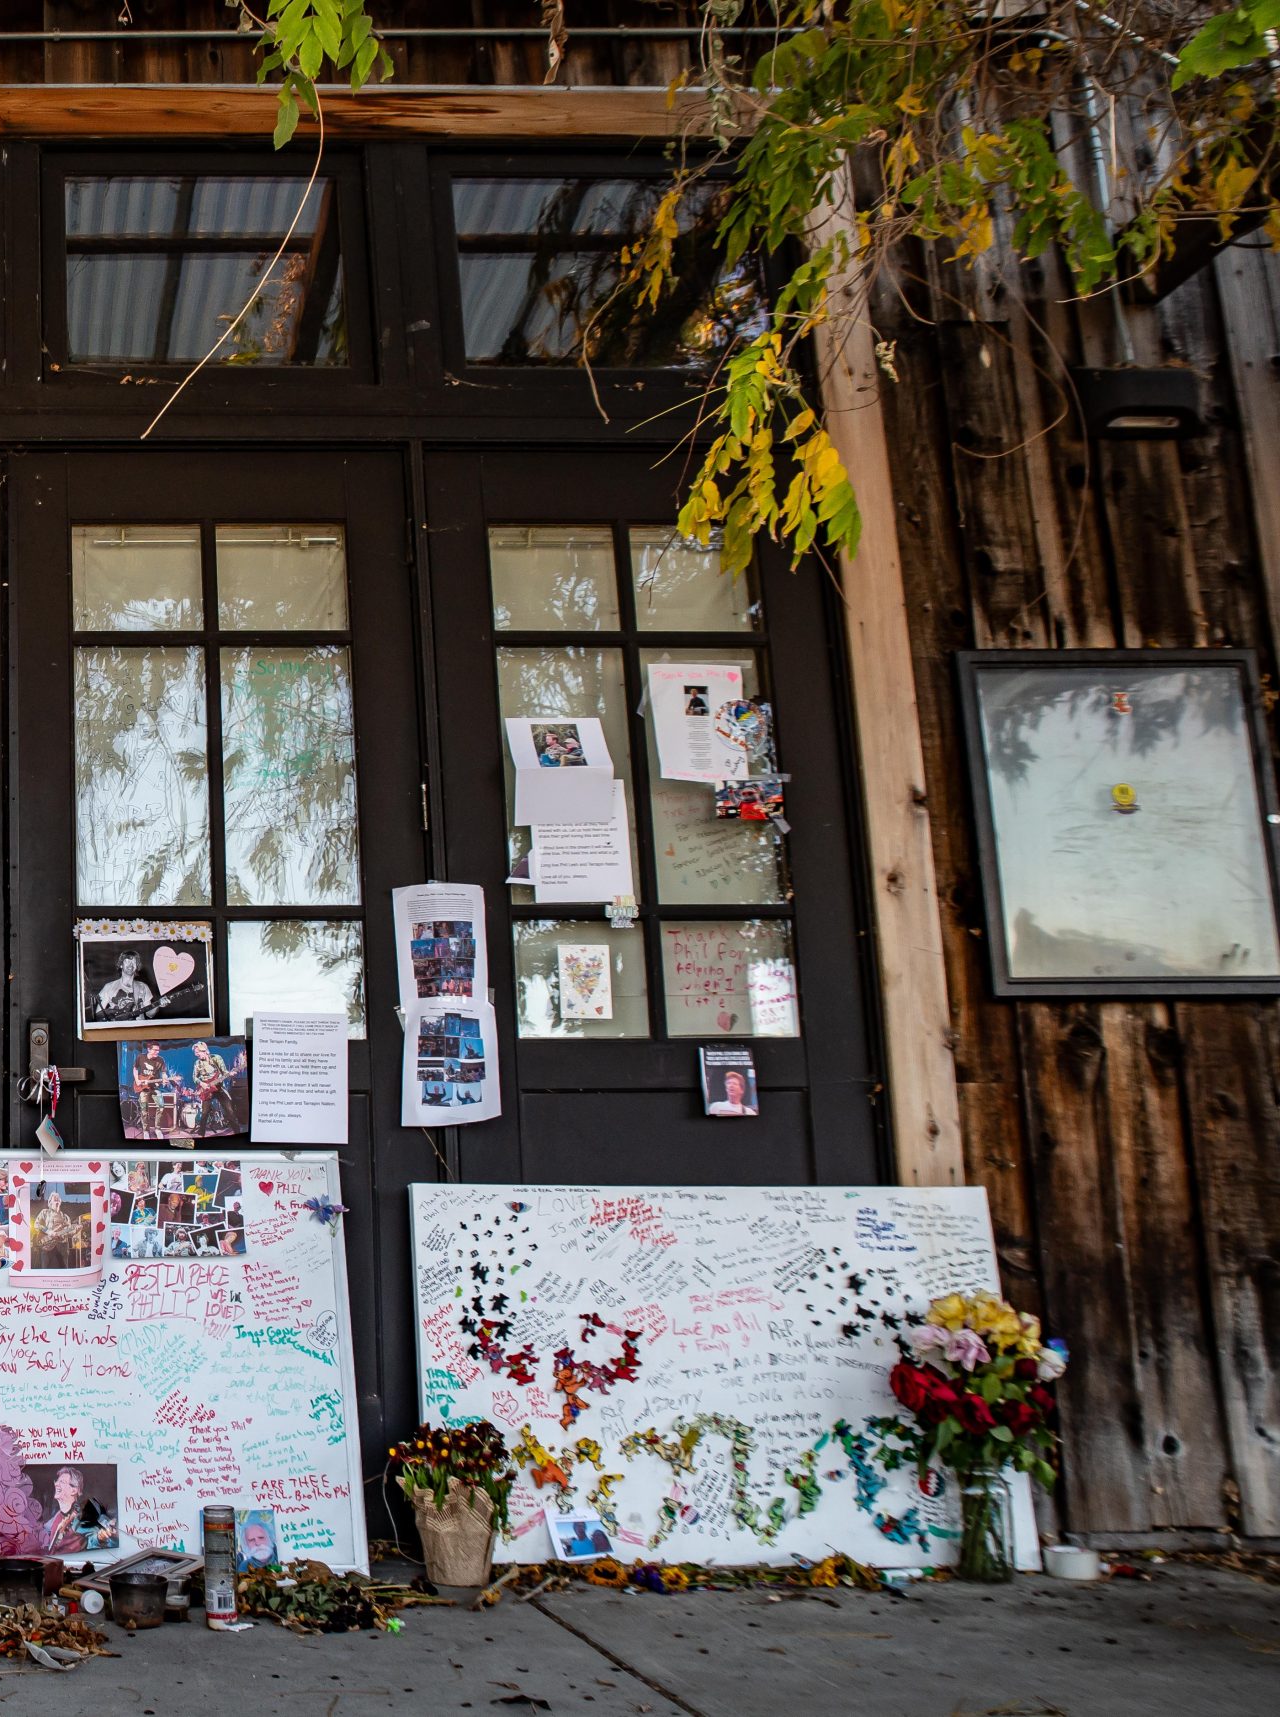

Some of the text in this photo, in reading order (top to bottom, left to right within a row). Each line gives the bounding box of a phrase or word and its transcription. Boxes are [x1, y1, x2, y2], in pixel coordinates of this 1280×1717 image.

[249, 1168, 283, 1180] THANK
[276, 1184, 307, 1196] PHIL
[536, 1194, 590, 1217] LOVE
[122, 1263, 230, 1295] REST IN PEACE
[16, 1304, 32, 1313] THE
[206, 1301, 245, 1321] LOVED
[20, 1326, 50, 1344] the
[58, 1326, 68, 1346] 4
[28, 1427, 68, 1438] YOU PHIL
[189, 1426, 211, 1434] Thank
[213, 1426, 227, 1436] you
[203, 1436, 221, 1444] being
[65, 1451, 84, 1461] NFA
[204, 1468, 215, 1476] you
[252, 1474, 329, 1490] FARE THEE
